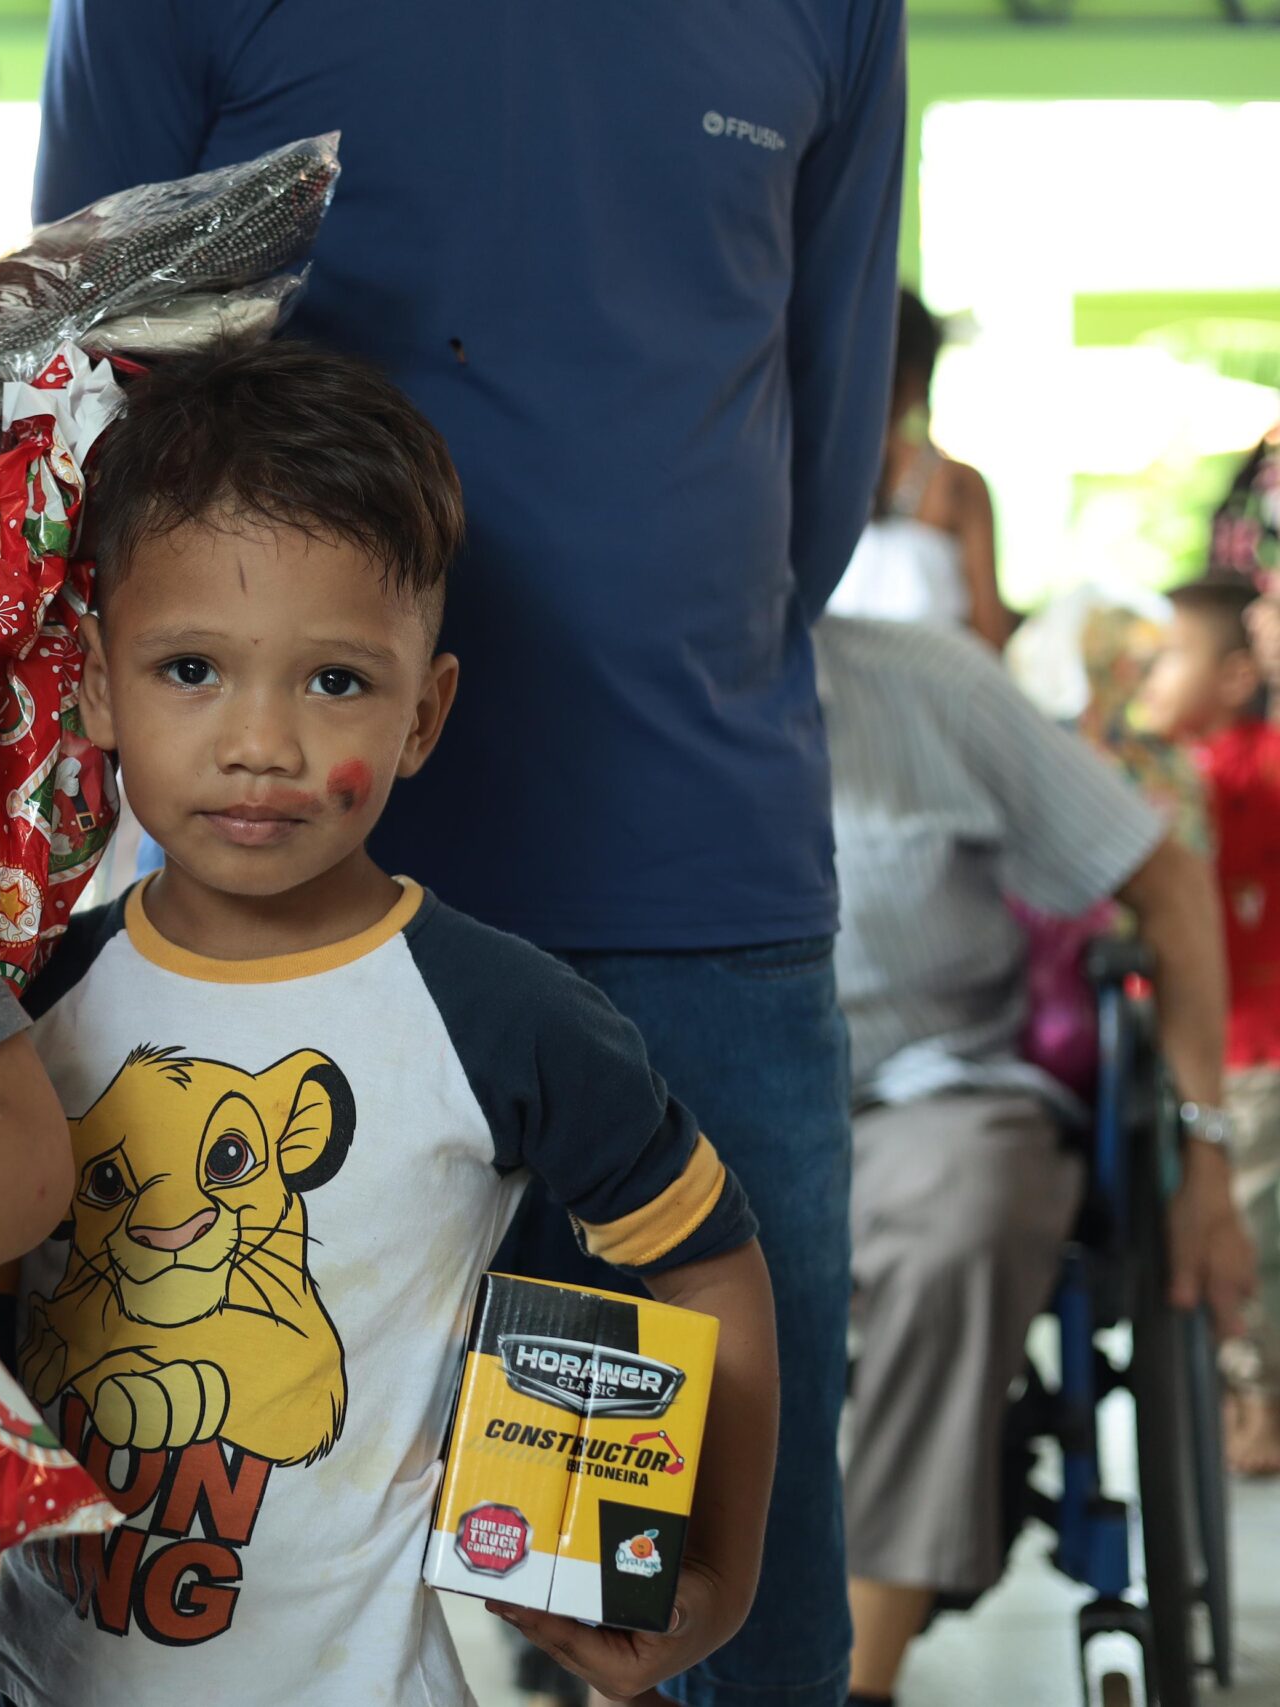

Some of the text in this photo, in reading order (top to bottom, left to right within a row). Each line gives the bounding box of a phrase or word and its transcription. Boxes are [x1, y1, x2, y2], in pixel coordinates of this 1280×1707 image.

[516, 1345, 663, 1394] HORANGR
[556, 1376, 618, 1398] CLASSIC
[485, 1419, 670, 1472] CONSTRUCTOR
[566, 1458, 649, 1486] BETONEIRA
[470, 1528, 518, 1551] TRUCK
[471, 1517, 521, 1539] BUILDER
[466, 1541, 517, 1561] COMPANY
